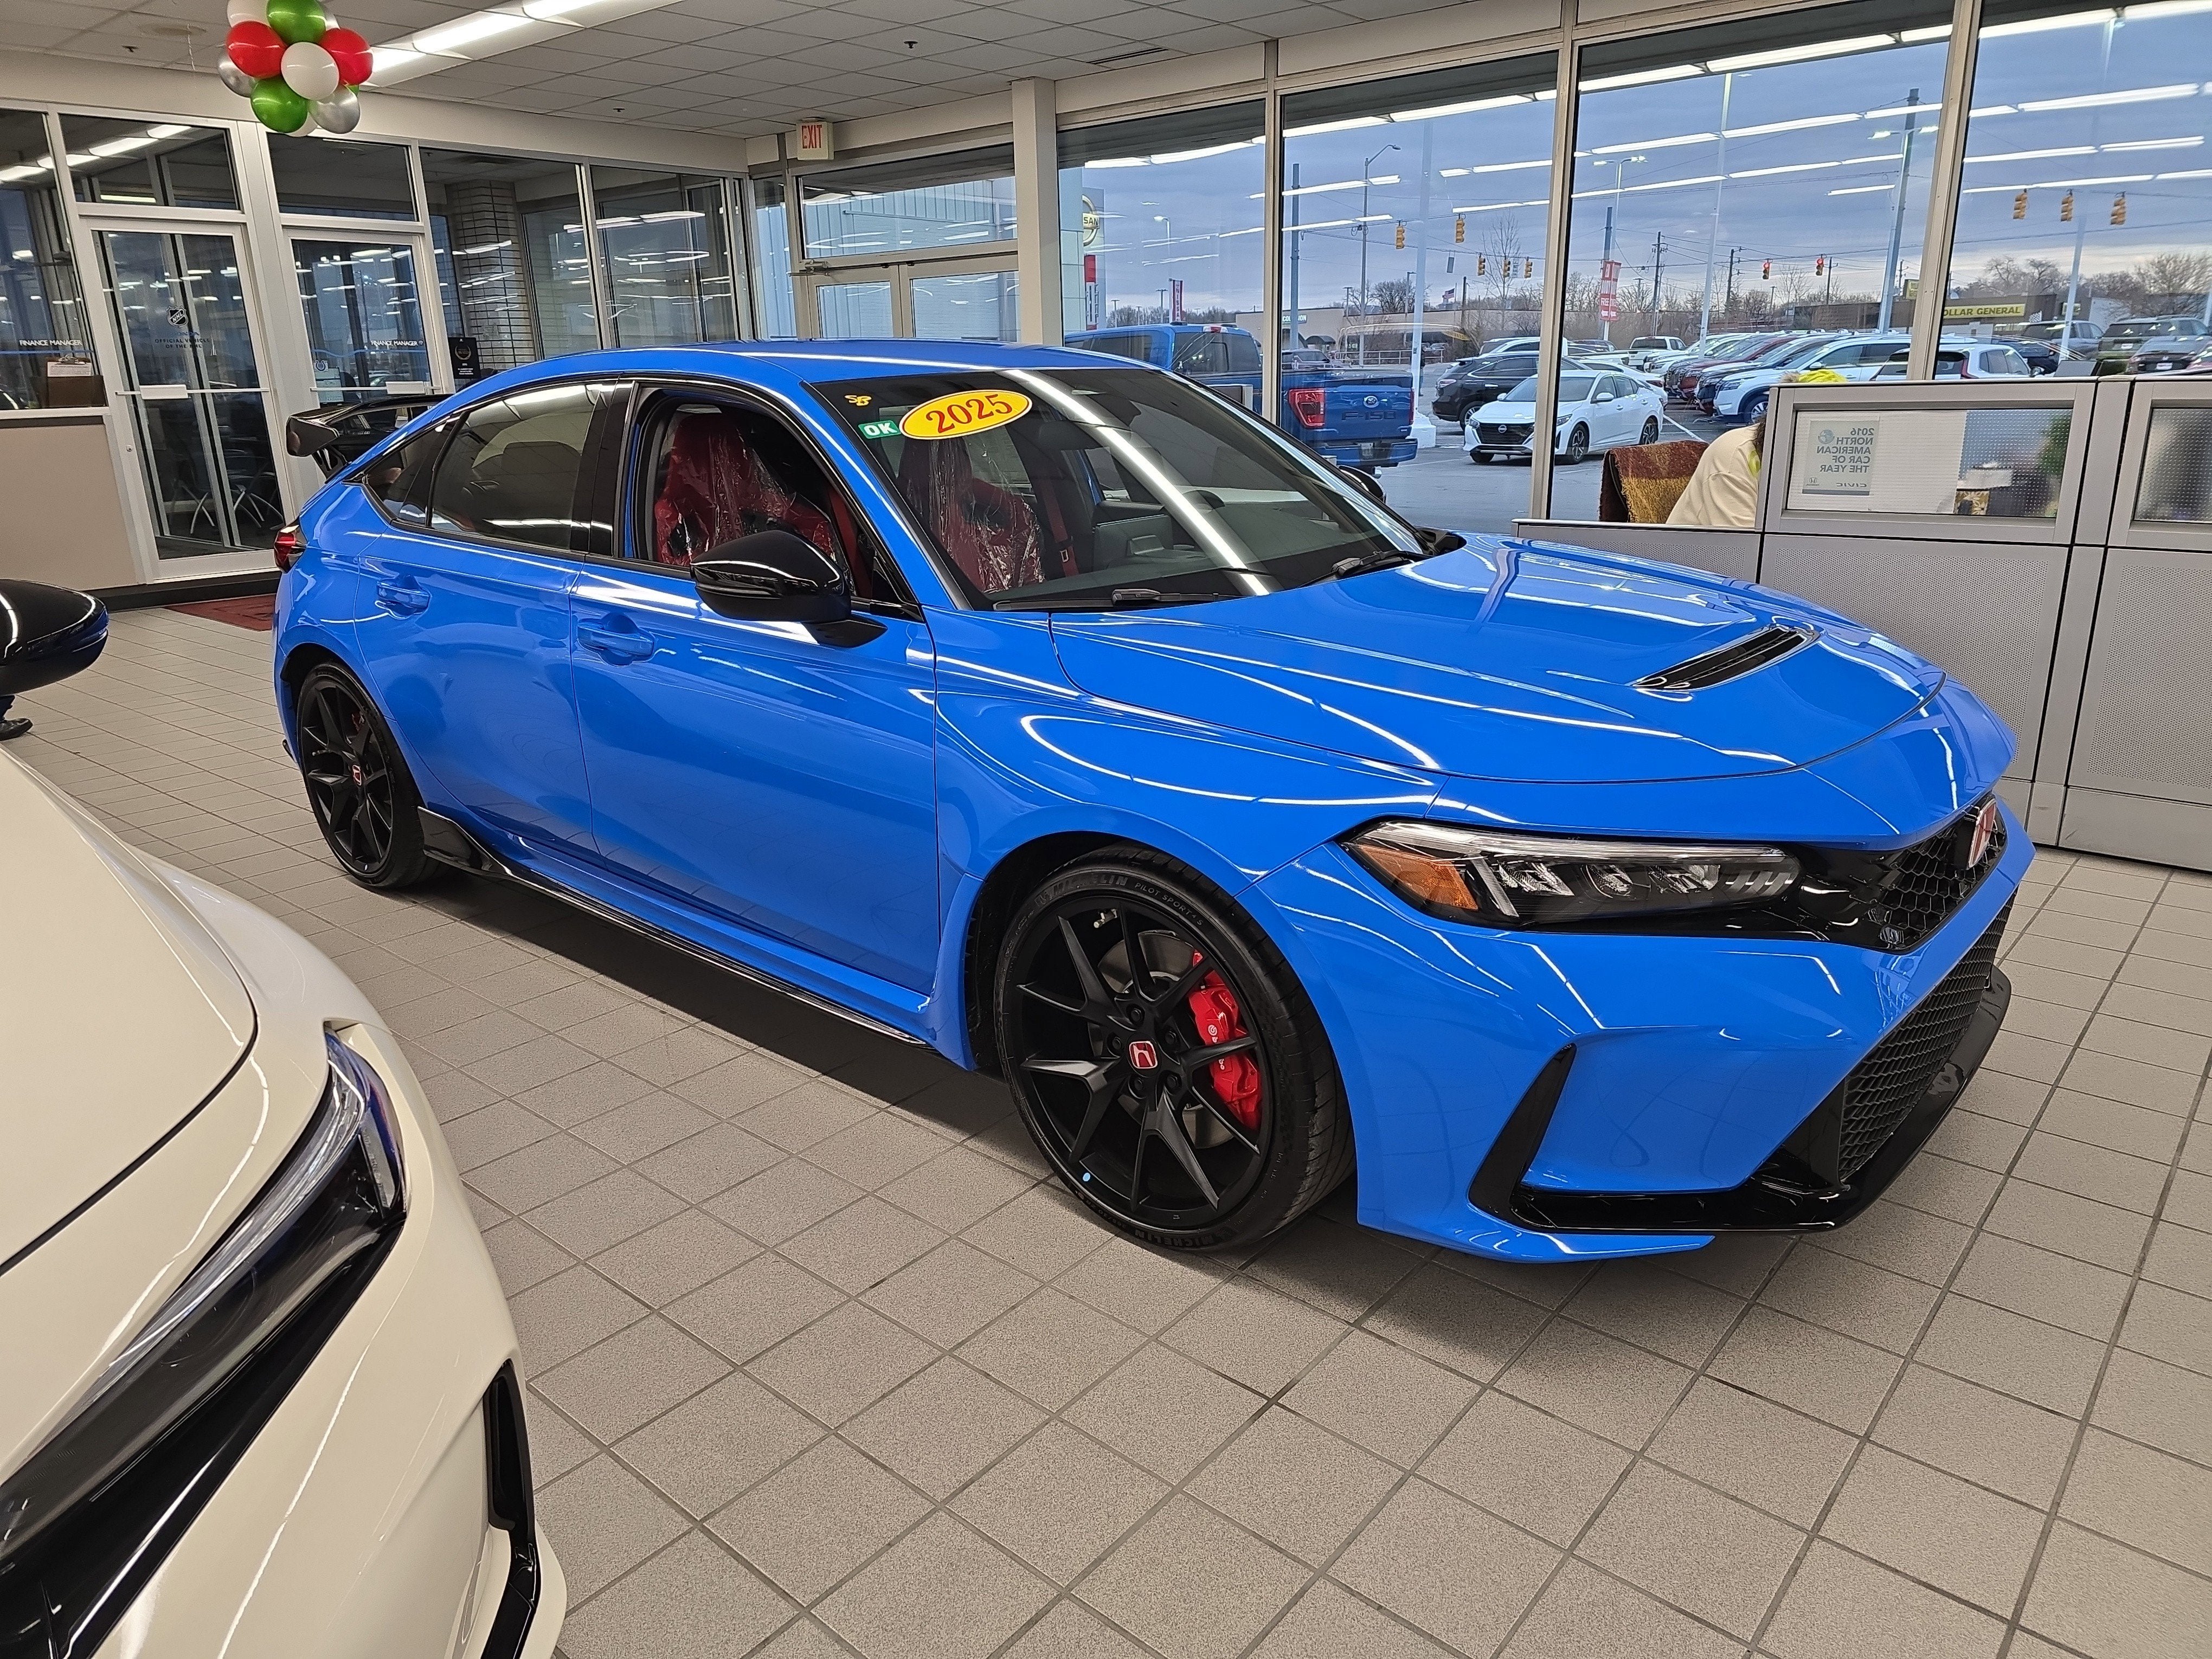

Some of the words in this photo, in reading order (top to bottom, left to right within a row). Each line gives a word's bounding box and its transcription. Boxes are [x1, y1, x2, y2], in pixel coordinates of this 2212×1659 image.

[802, 124, 823, 149] EXIT
[1083, 217, 1098, 226] SAN
[1943, 308, 1973, 317] OLLAR
[1976, 306, 2021, 316] GENERAL
[925, 393, 1013, 434] 2025
[1341, 411, 1397, 421] F-150
[864, 422, 898, 437] OK
[1135, 883, 1160, 896] PILOT
[1135, 1229, 1213, 1246] MICHELIN
